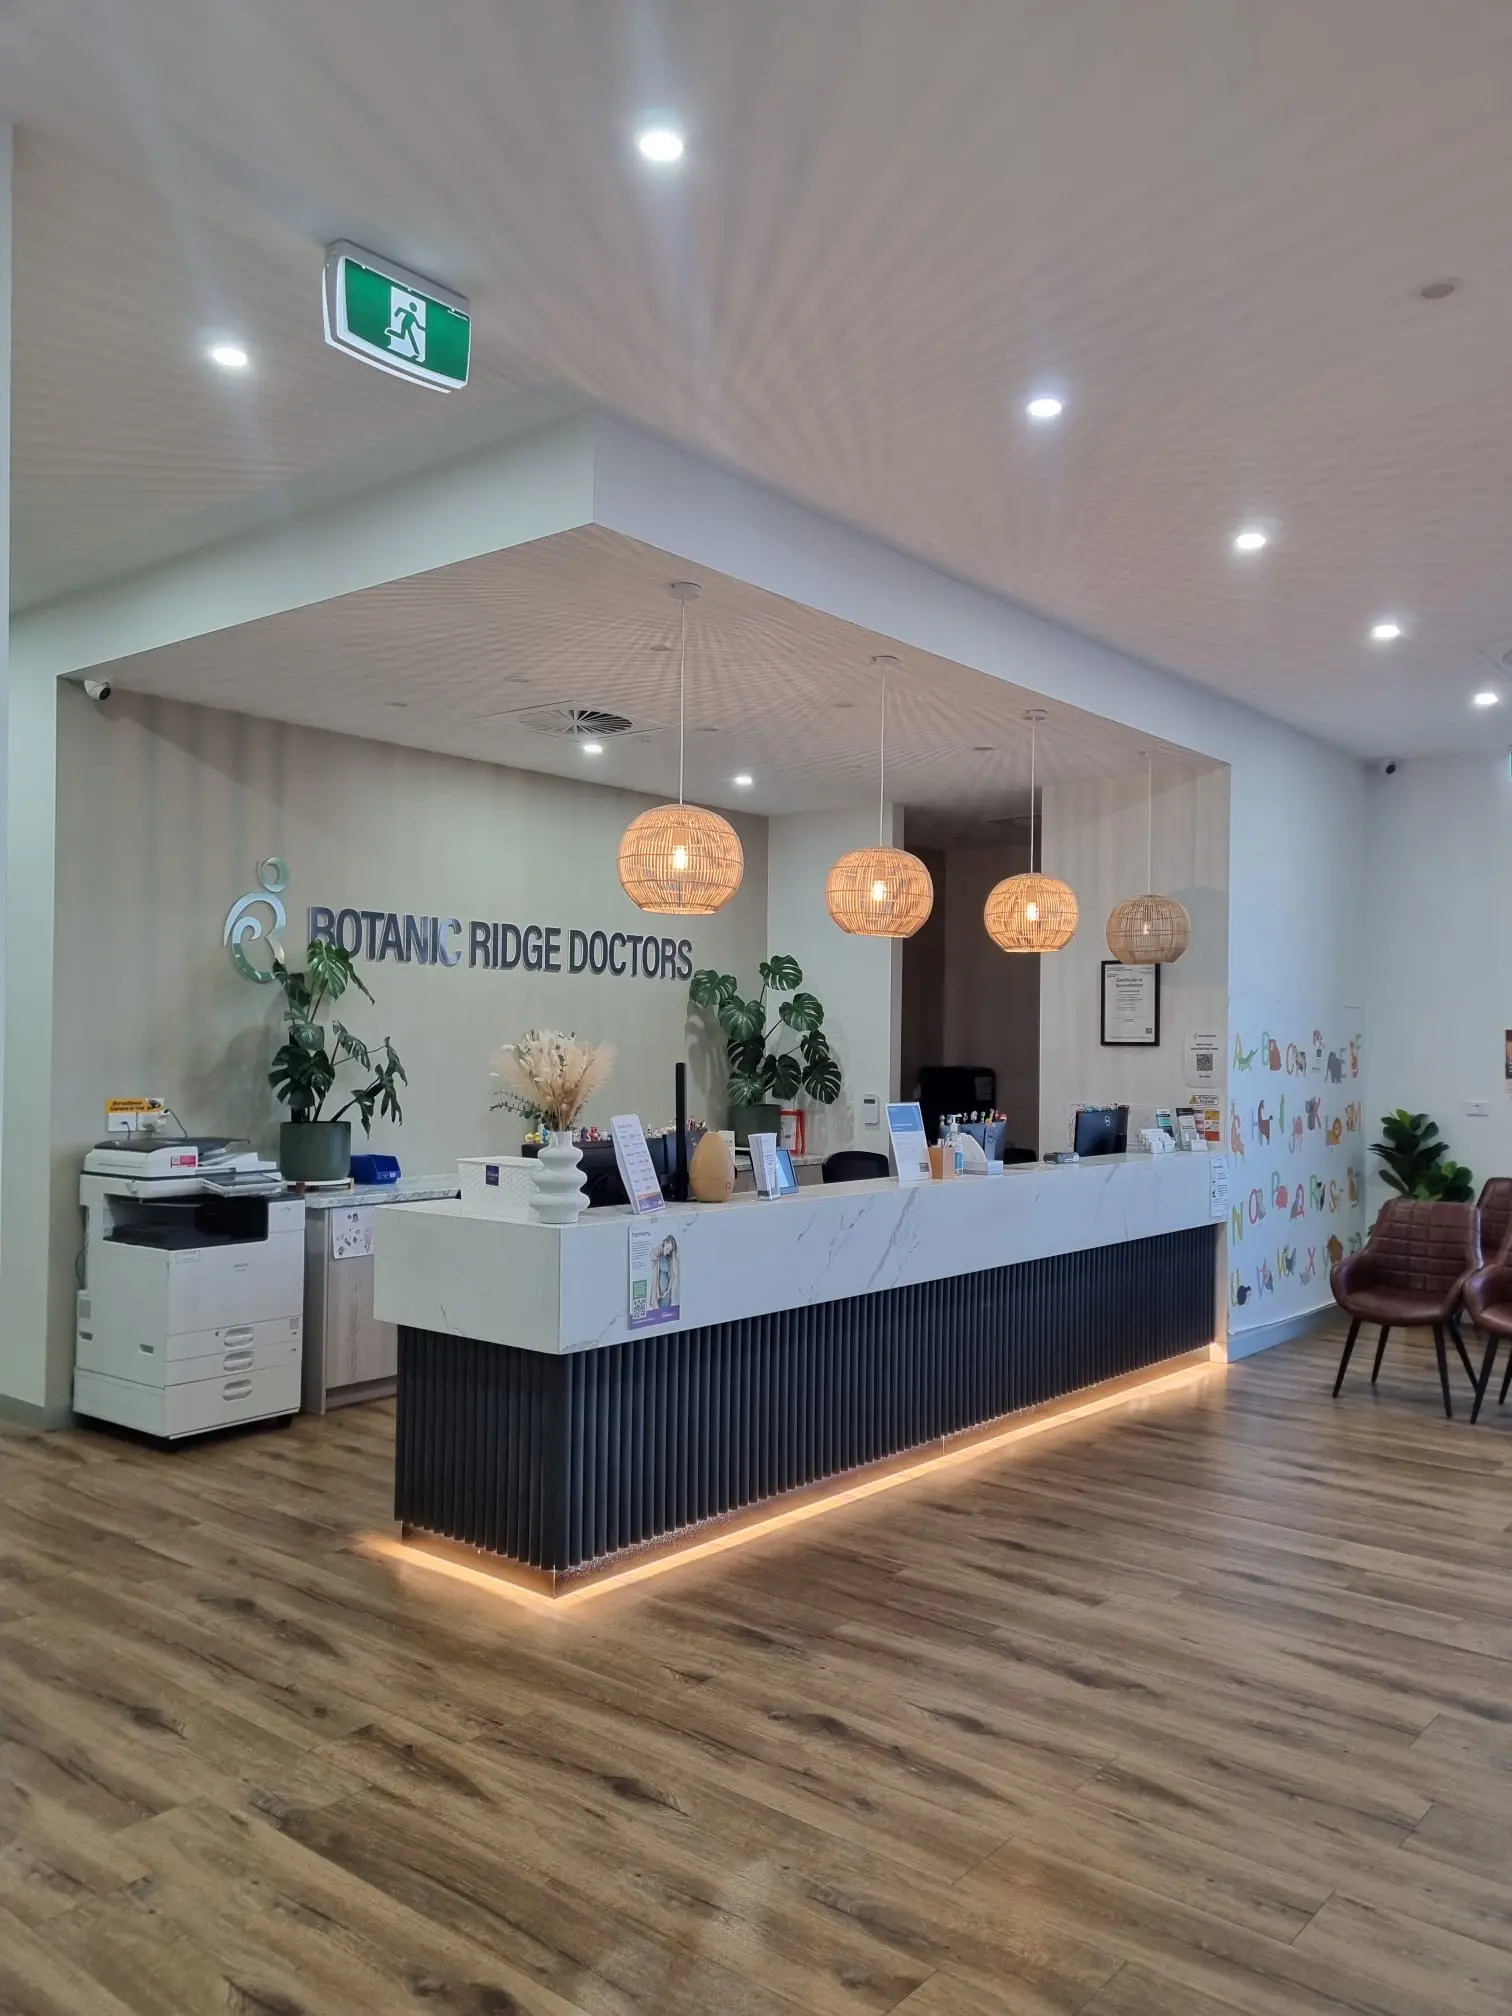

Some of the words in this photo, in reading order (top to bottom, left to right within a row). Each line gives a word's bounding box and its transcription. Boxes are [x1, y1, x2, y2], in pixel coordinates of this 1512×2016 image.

[309, 905, 462, 968] BOTANIC
[469, 920, 562, 974] RIDGE
[568, 929, 693, 981] DOCTORS
